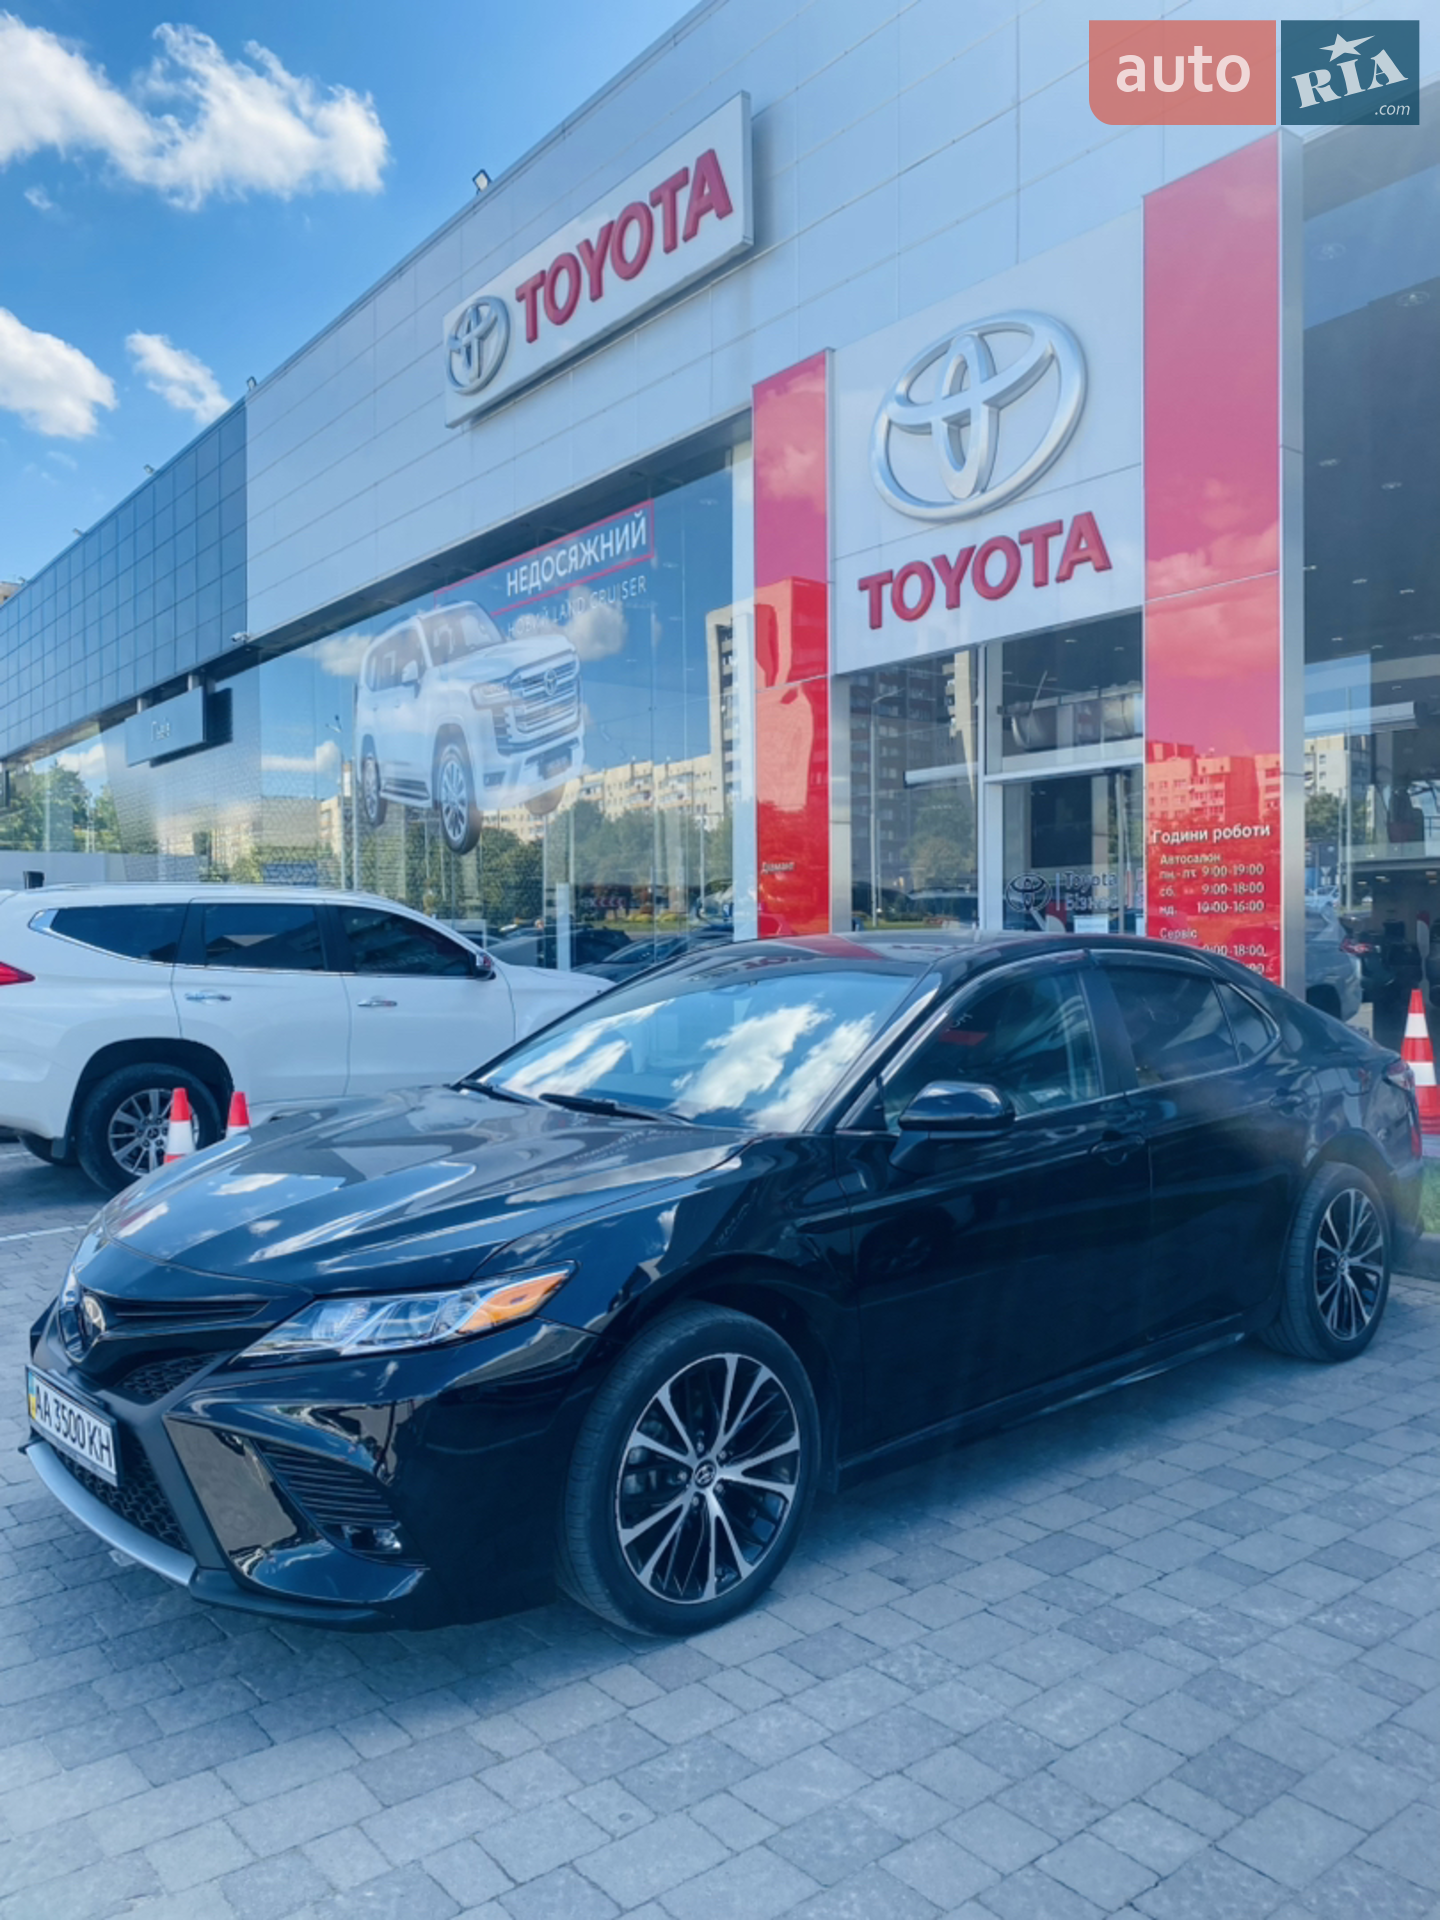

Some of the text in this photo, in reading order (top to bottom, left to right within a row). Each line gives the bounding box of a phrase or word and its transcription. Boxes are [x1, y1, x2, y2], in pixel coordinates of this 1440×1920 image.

[515, 148, 733, 344] TOYOTA
[506, 510, 647, 597] НЕДОСЯЖНИЙ
[858, 511, 1112, 630] TOYOTA
[1152, 824, 1271, 844] Години роботи
